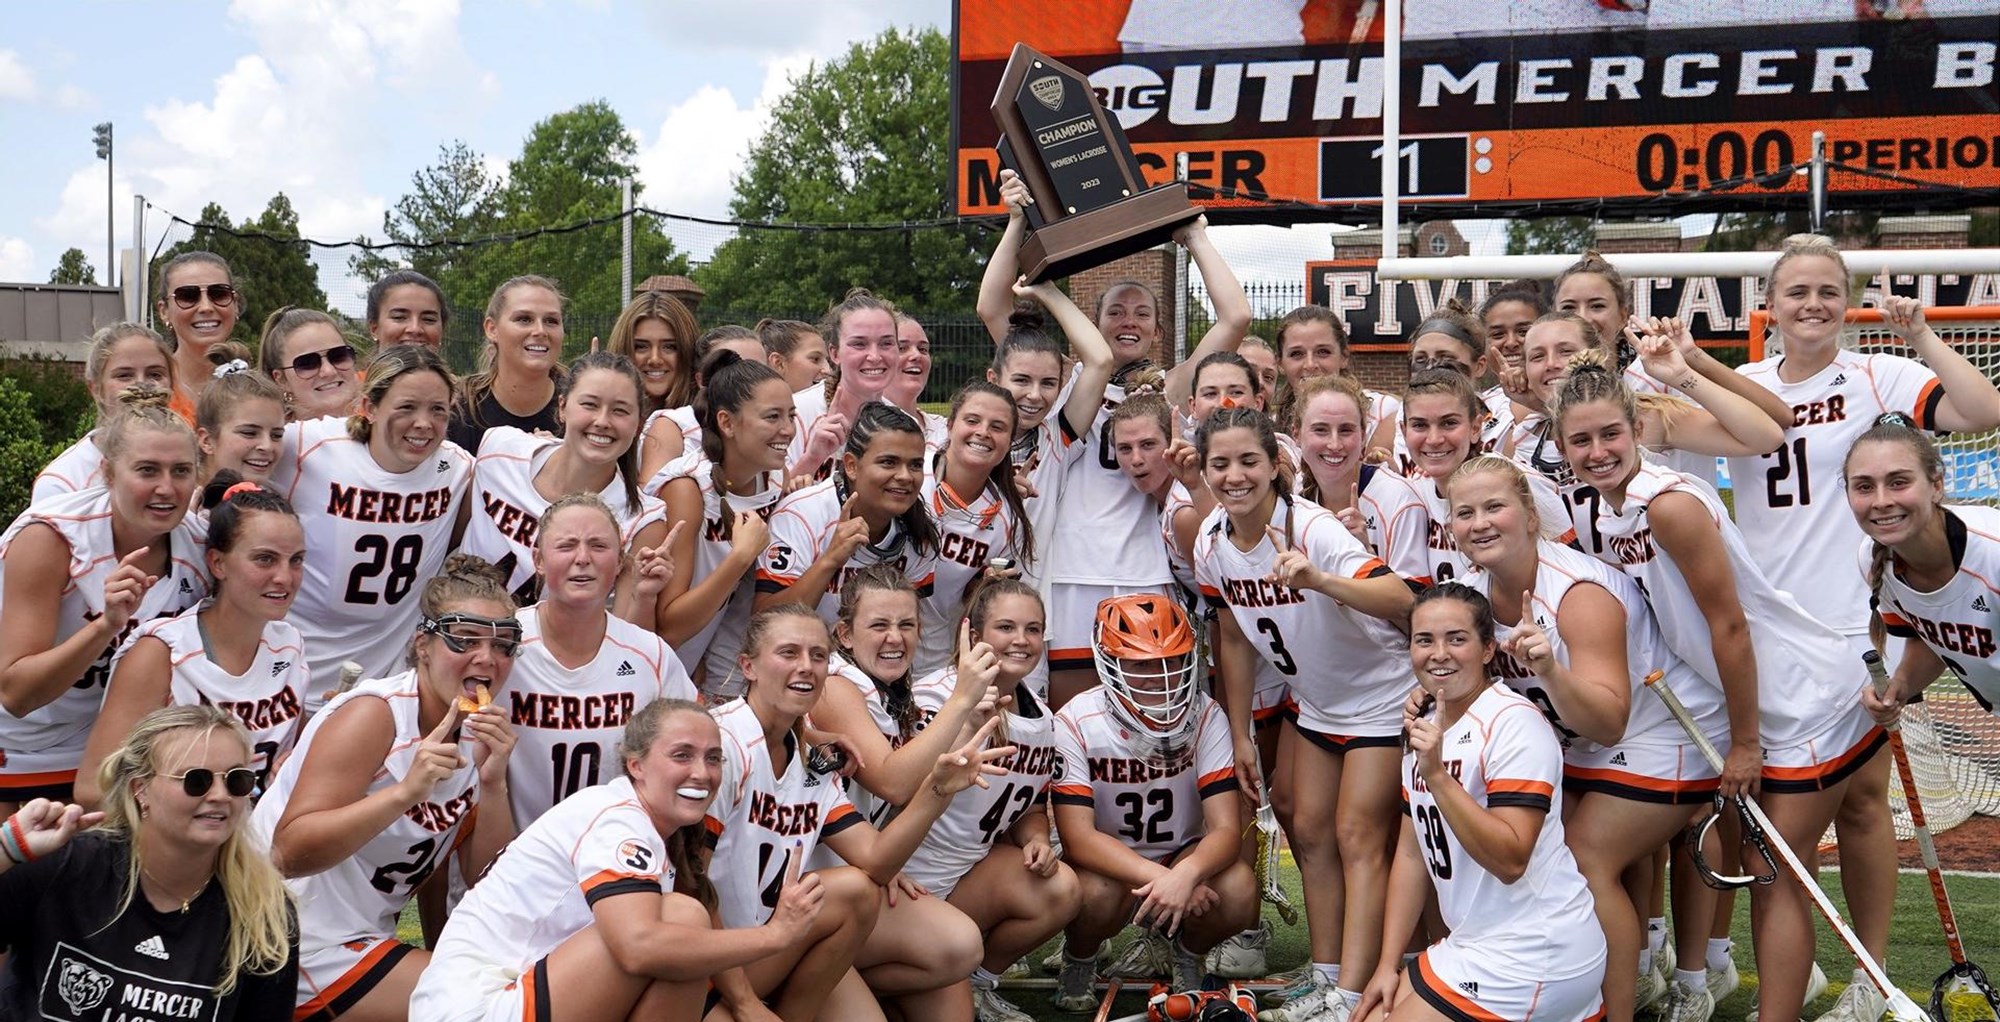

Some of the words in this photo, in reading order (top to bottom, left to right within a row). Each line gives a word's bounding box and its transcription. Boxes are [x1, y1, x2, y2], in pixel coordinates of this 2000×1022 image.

[1418, 45, 1874, 107] MERCER
[1038, 118, 1098, 145] CHAMPION
[1049, 153, 1079, 170] WOMEN'S
[1077, 145, 1108, 162] LACROSSE
[1635, 128, 1794, 192] 0:00
[1833, 135, 2000, 171] PERIO
[1080, 178, 1101, 190] 2023
[1791, 394, 1846, 428] CER
[1761, 436, 1810, 508] 21
[327, 481, 452, 523] MERCER
[344, 534, 424, 605] 28
[942, 532, 990, 569] CER
[1257, 617, 1298, 676] 3
[510, 690, 635, 731] MERCER
[551, 741, 601, 801] 10
[1115, 788, 1174, 843] 32
[1416, 804, 1453, 880] 39
[121, 983, 204, 1019] MERCER
